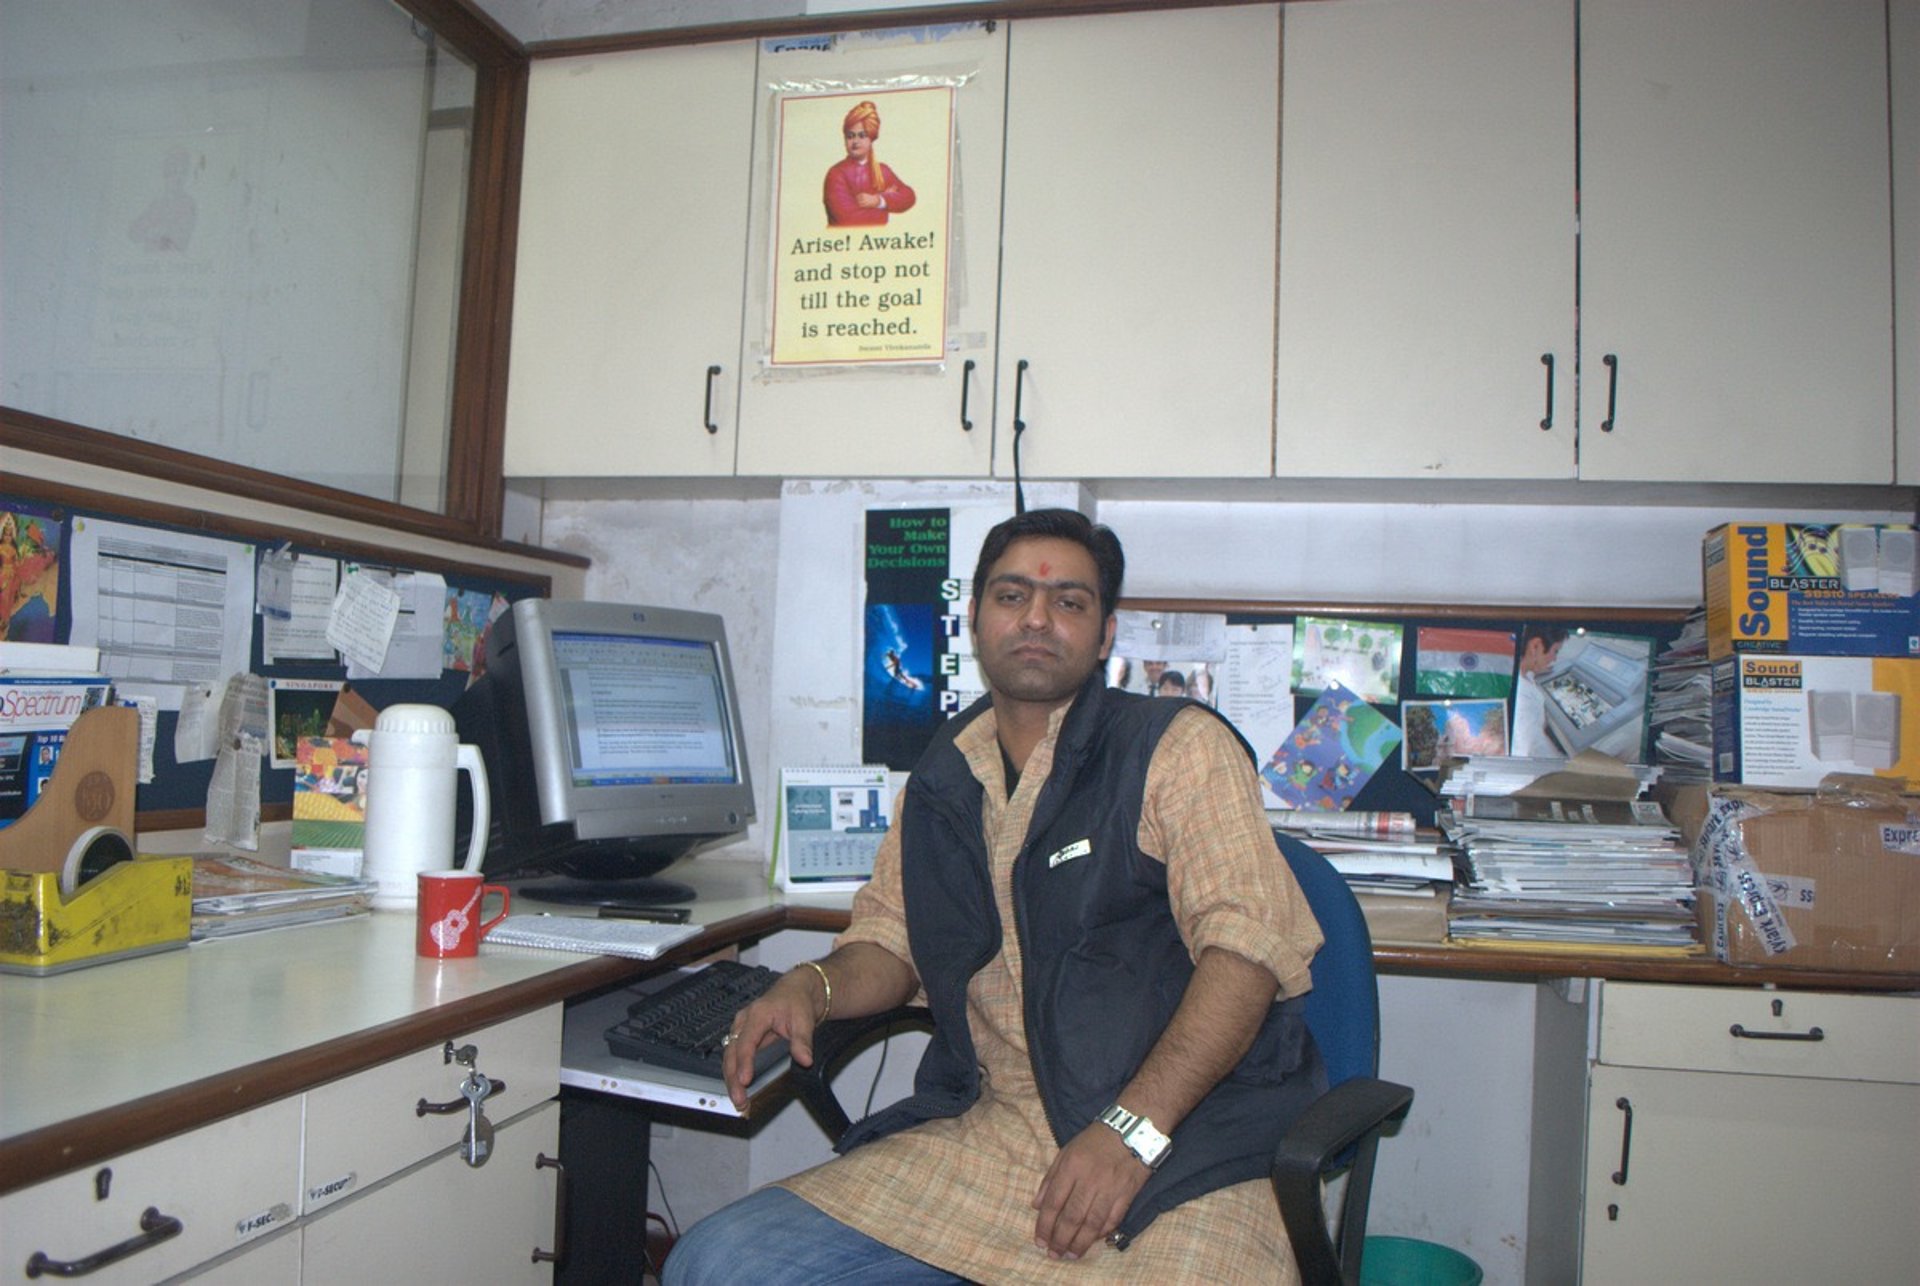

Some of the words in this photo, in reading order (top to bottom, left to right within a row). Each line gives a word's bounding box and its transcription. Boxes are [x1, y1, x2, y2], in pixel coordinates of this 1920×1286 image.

[791, 235, 851, 255] Arise!
[858, 231, 934, 251] Awake!
[794, 263, 832, 282] and
[841, 264, 886, 283] stop
[895, 261, 930, 278] not
[801, 291, 827, 310] till
[837, 291, 870, 308] the
[878, 288, 922, 312] goal
[802, 322, 818, 338] is
[827, 317, 918, 337] reached.
[889, 517, 926, 529] How
[931, 517, 947, 528] to
[903, 530, 946, 541] Make
[868, 544, 904, 555] Your
[910, 543, 946, 554] Own
[867, 557, 946, 568] Decisions
[1737, 526, 1770, 636] Sound
[1770, 578, 1839, 590] BLASTER
[1746, 661, 1800, 673] Sound
[286, 681, 334, 689] SINGAPORE
[1745, 677, 1800, 687] BLASTER
